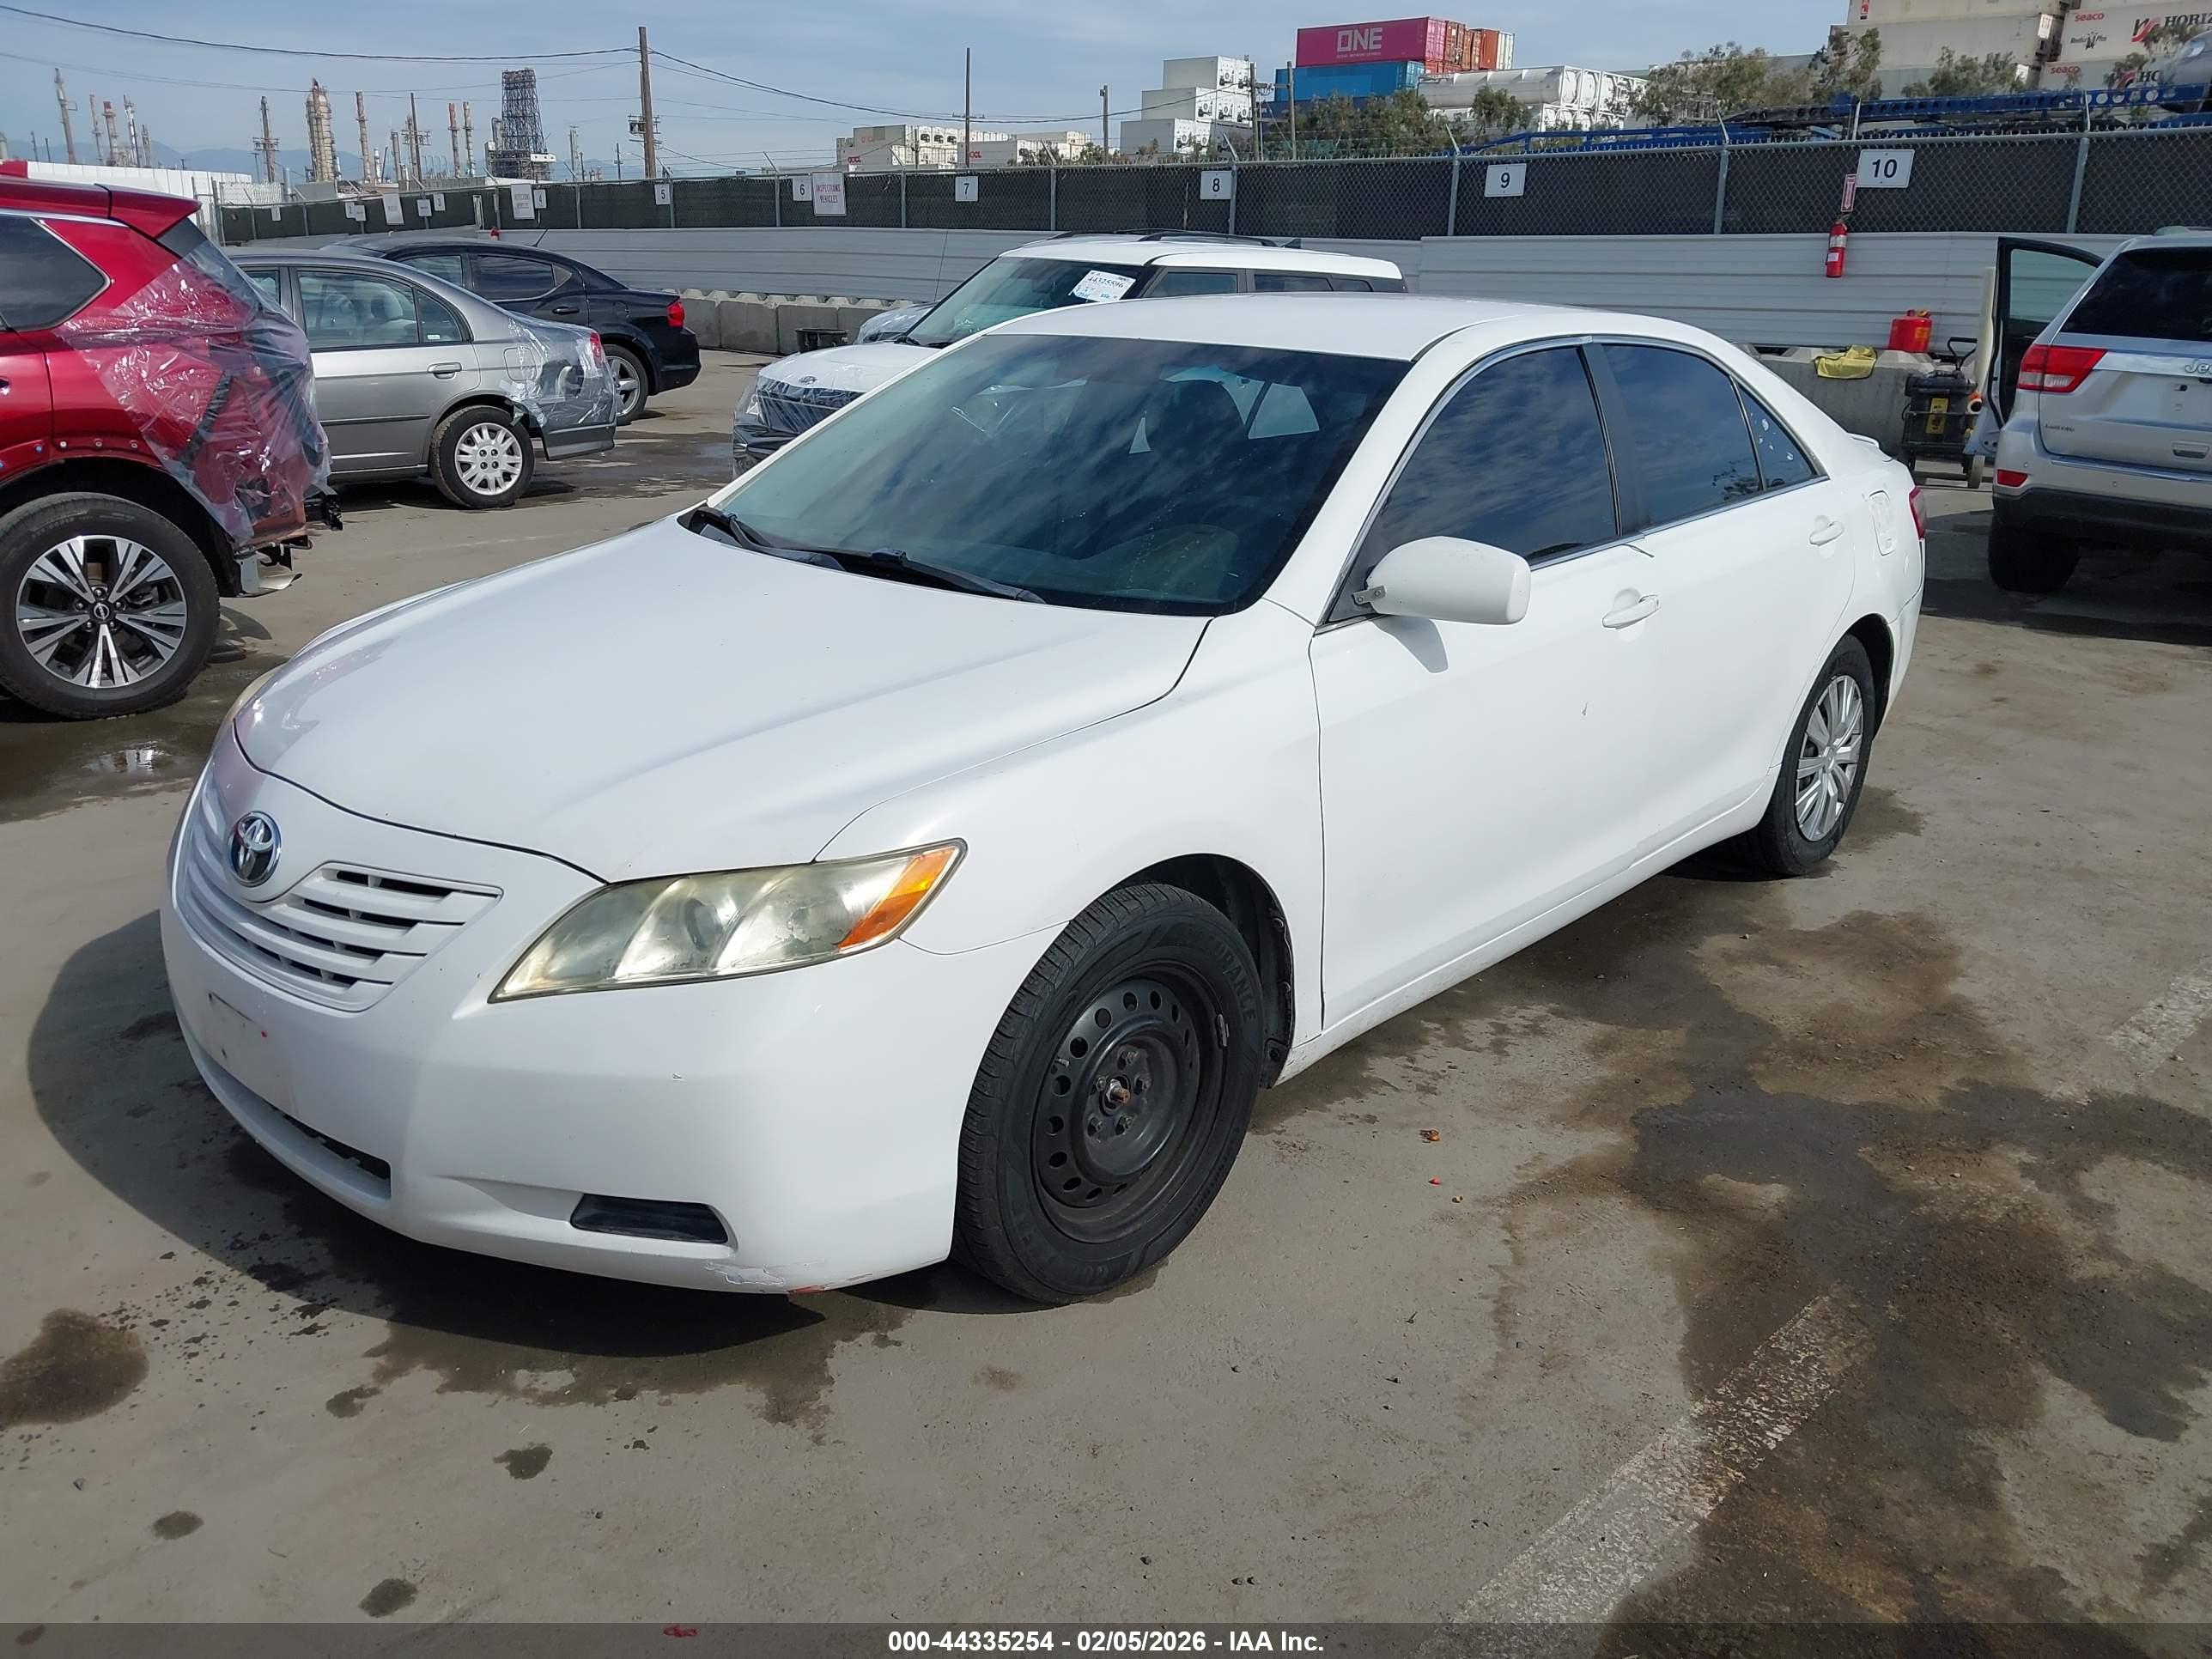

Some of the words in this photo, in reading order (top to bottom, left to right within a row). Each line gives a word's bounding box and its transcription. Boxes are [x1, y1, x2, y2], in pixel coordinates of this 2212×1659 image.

[2074, 13, 2105, 22] seaco
[1336, 27, 1383, 52] ONE
[1871, 158, 1898, 179] 10
[1212, 177, 1220, 193] 8
[1500, 172, 1510, 189] 9
[660, 188, 666, 200] 5
[799, 183, 805, 196] 6
[963, 182, 970, 196] 7
[2185, 357, 2212, 375] Je
